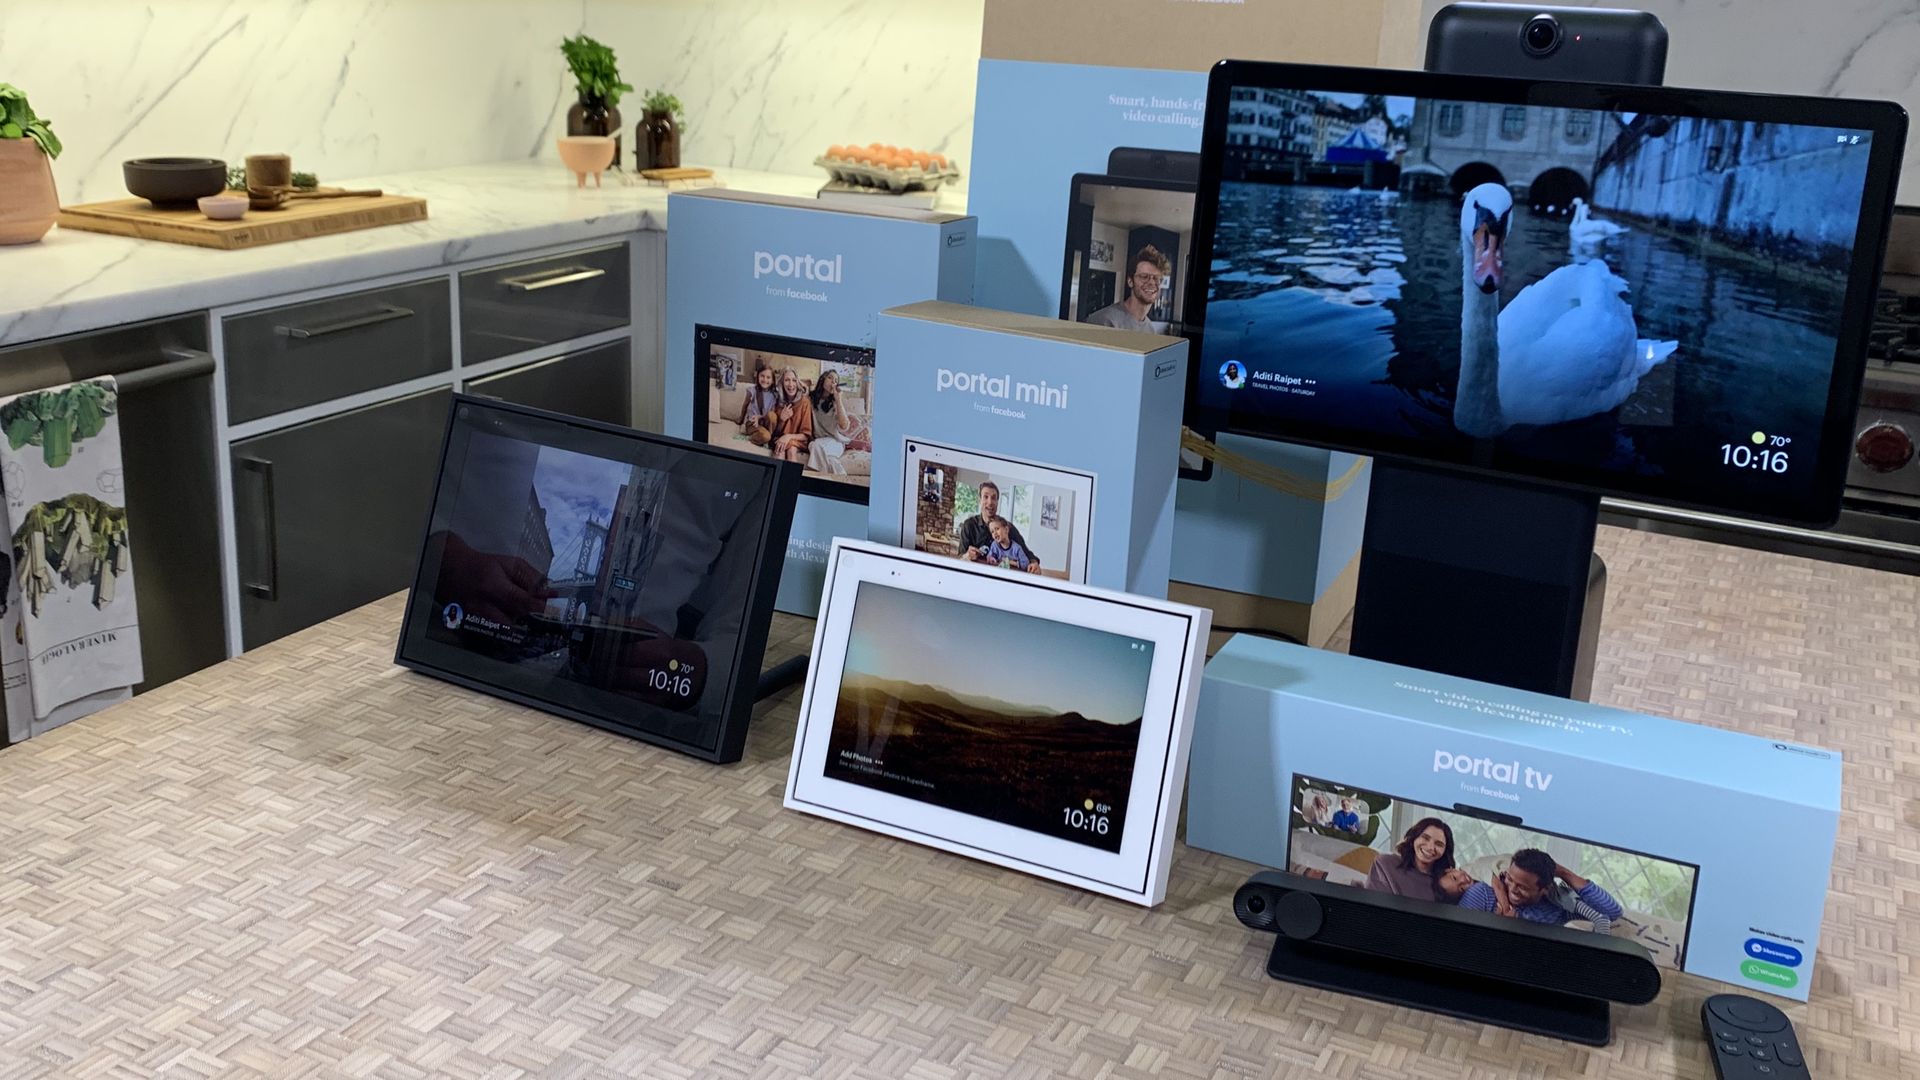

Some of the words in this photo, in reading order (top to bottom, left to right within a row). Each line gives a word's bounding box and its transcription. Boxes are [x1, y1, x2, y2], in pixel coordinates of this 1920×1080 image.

[1108, 94, 1149, 108] Smart,
[1151, 96, 1205, 110] hands-fr
[1122, 109, 1156, 122] video
[753, 250, 842, 284] portal
[766, 284, 786, 297] from
[786, 287, 829, 303] facebook
[1252, 370, 1273, 381] Aditi
[936, 367, 1011, 399] portal
[1015, 380, 1068, 409] mini
[1252, 381, 1269, 390] TRAVEL
[1269, 384, 1289, 393] PHOTOS
[1291, 387, 1316, 397] SATURDAY
[973, 401, 990, 413] from
[991, 405, 1026, 420] facebook
[1770, 434, 1791, 447] 70°
[1721, 443, 1789, 473] 10:16
[788, 535, 805, 549] ing
[805, 539, 831, 553] desig
[680, 662, 695, 674] 70°
[648, 668, 692, 697] 10:16
[1392, 680, 1439, 696] Smart
[1443, 691, 1485, 705] video
[1487, 701, 1540, 717] calling
[1543, 712, 1564, 722] on
[1565, 717, 1603, 729] your
[1434, 697, 1469, 709] with
[1470, 705, 1516, 720] Alexa
[840, 749, 852, 760] Add
[852, 752, 873, 765] Photos
[1433, 749, 1520, 785] portal
[1524, 765, 1553, 792] tv
[1460, 781, 1479, 793] from
[1480, 785, 1521, 802] facebook
[1063, 807, 1109, 835] 10:16
[1762, 947, 1796, 961] Messenger
